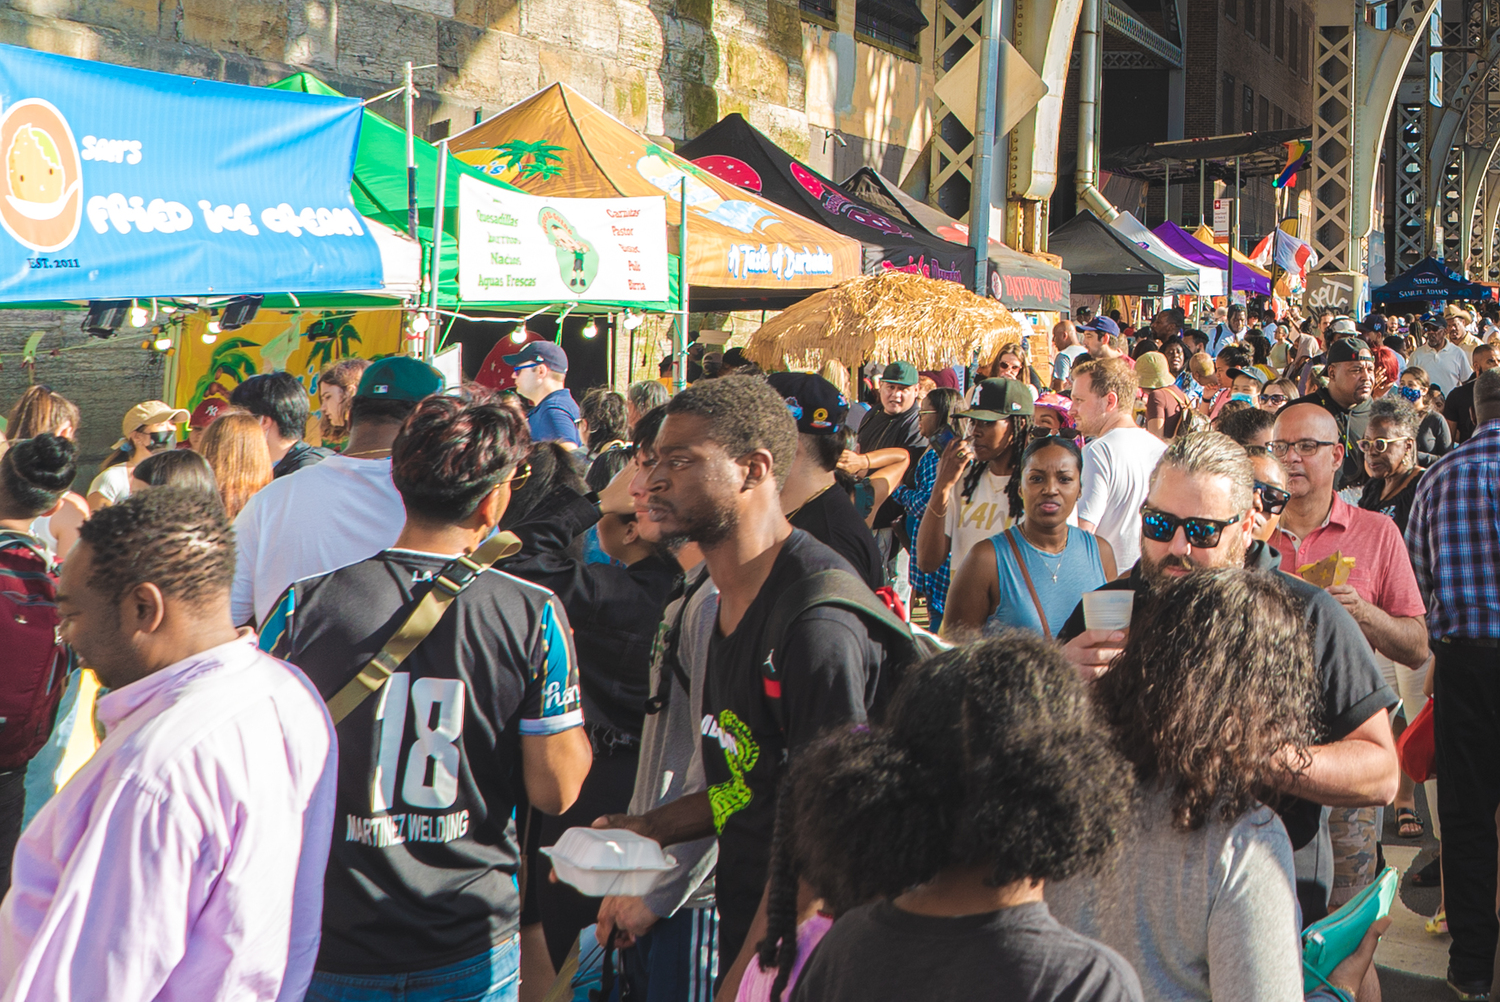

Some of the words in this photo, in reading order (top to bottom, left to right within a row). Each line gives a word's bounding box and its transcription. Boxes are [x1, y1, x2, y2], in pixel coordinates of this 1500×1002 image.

[261, 203, 364, 237] CREAM
[27, 258, 53, 269] EST.
[55, 258, 80, 269] 2011
[740, 243, 770, 279] Taste
[478, 274, 504, 290] Aguas
[506, 275, 536, 287] Frescas
[1398, 290, 1424, 299] SAMUEL
[1426, 288, 1449, 297] ADAMS
[371, 672, 466, 813] 18
[345, 814, 406, 848] MARTINEZ
[407, 809, 470, 844] WELDING
